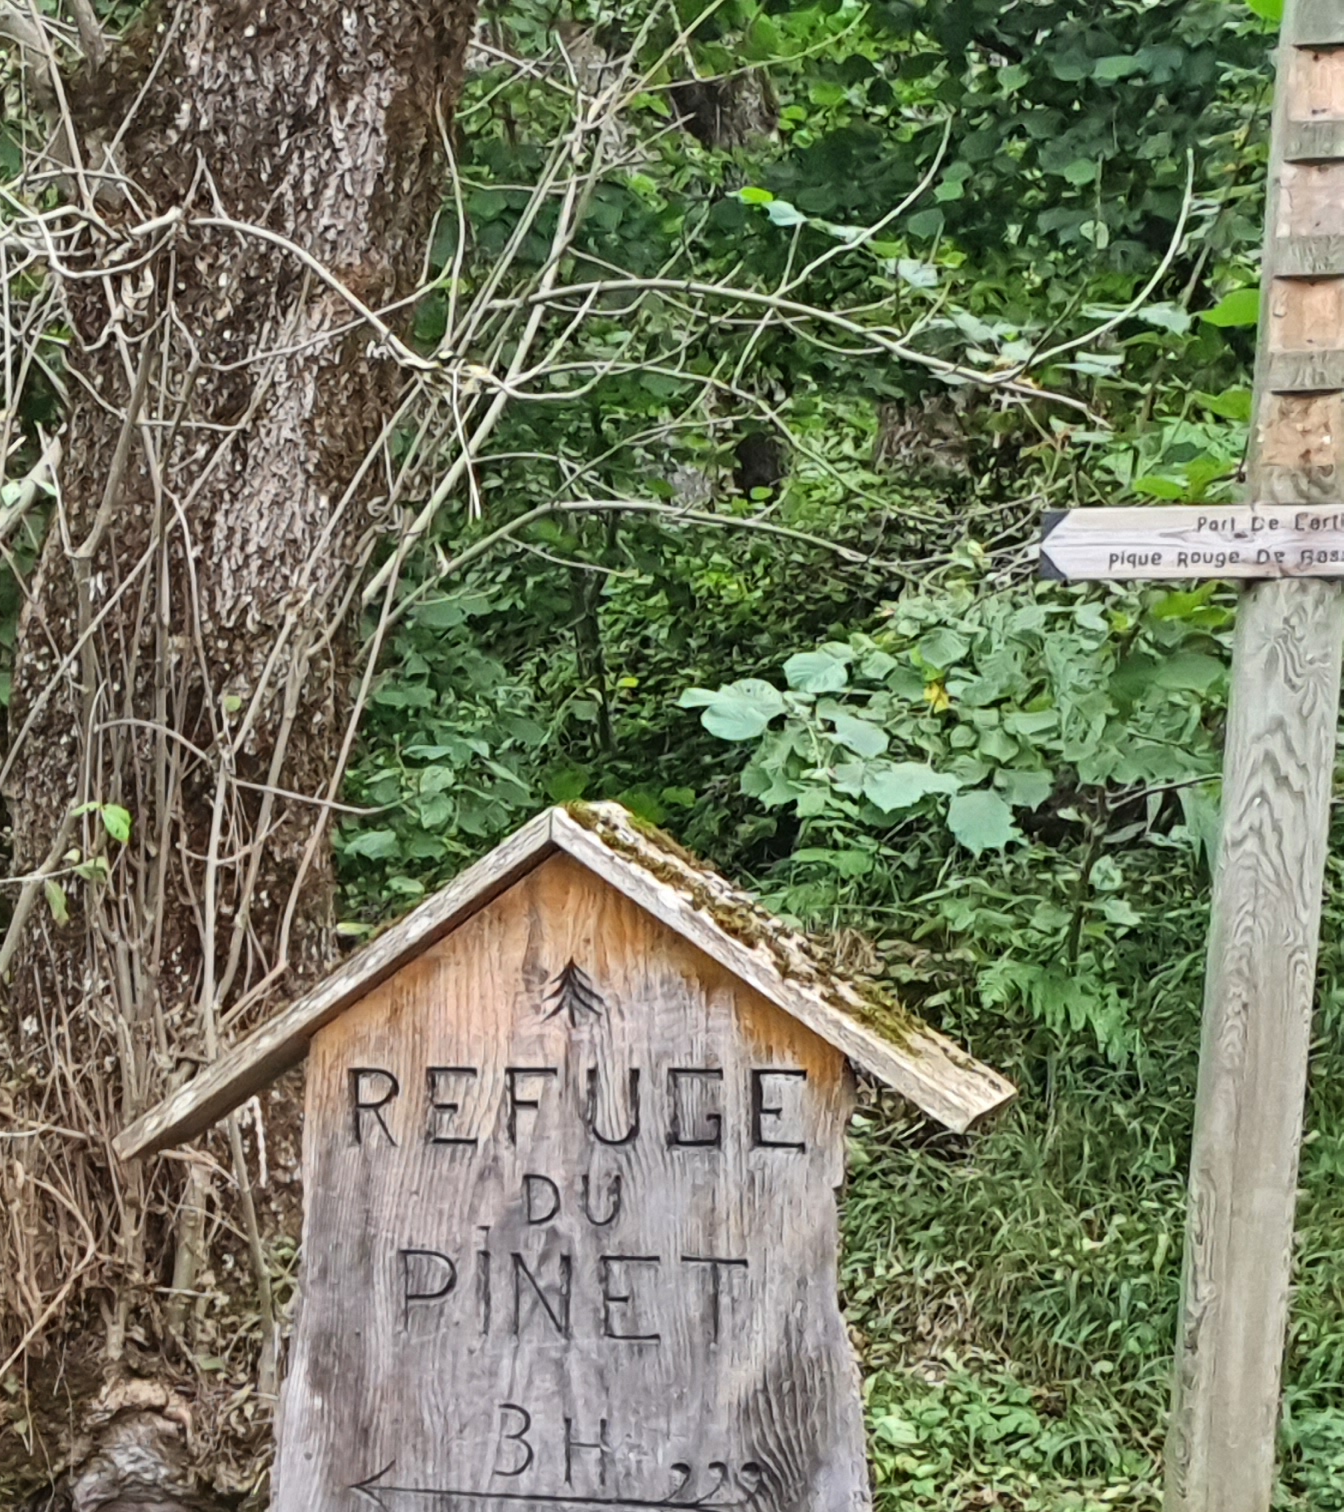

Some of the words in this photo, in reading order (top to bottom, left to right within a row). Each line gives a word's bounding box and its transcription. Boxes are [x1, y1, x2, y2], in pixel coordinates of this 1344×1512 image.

[1177, 551, 1240, 568] Rouge
[1257, 549, 1285, 565] De
[1251, 516, 1279, 532] De
[347, 1066, 808, 1154] REFUGE
[522, 1173, 622, 1227] DU
[399, 1226, 749, 1345] PINET
[493, 1403, 534, 1477] 3
[564, 1417, 609, 1487] H
